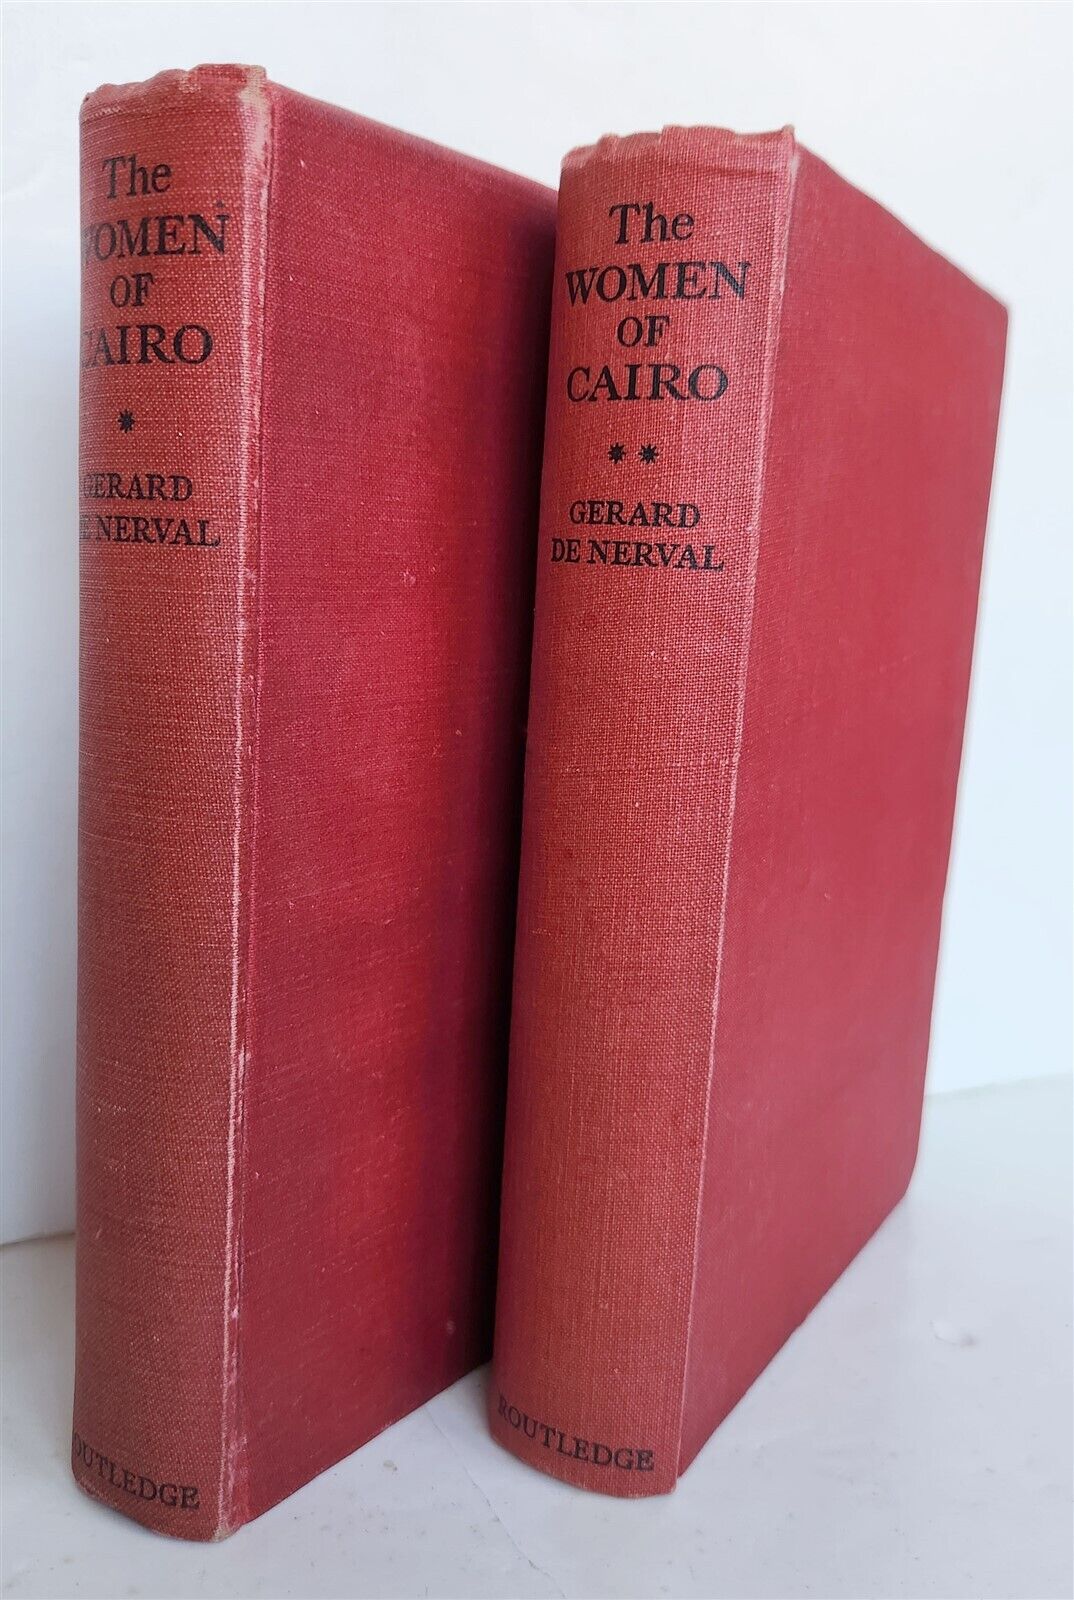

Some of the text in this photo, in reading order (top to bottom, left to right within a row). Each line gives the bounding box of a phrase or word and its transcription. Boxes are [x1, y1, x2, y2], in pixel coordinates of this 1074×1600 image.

[102, 153, 172, 199] The
[82, 213, 230, 264] OMEN
[608, 201, 694, 245] The
[110, 272, 155, 308] OF
[565, 261, 751, 307] WOMEN
[617, 315, 670, 347] OF
[567, 363, 729, 403] CAIRO
[95, 515, 221, 547] NERVAL
[569, 500, 701, 528] GERARD
[551, 538, 725, 571] DE NERVAL
[498, 1394, 655, 1471] ROUTLEDGE
[72, 1432, 200, 1510] OUTLEDGE
